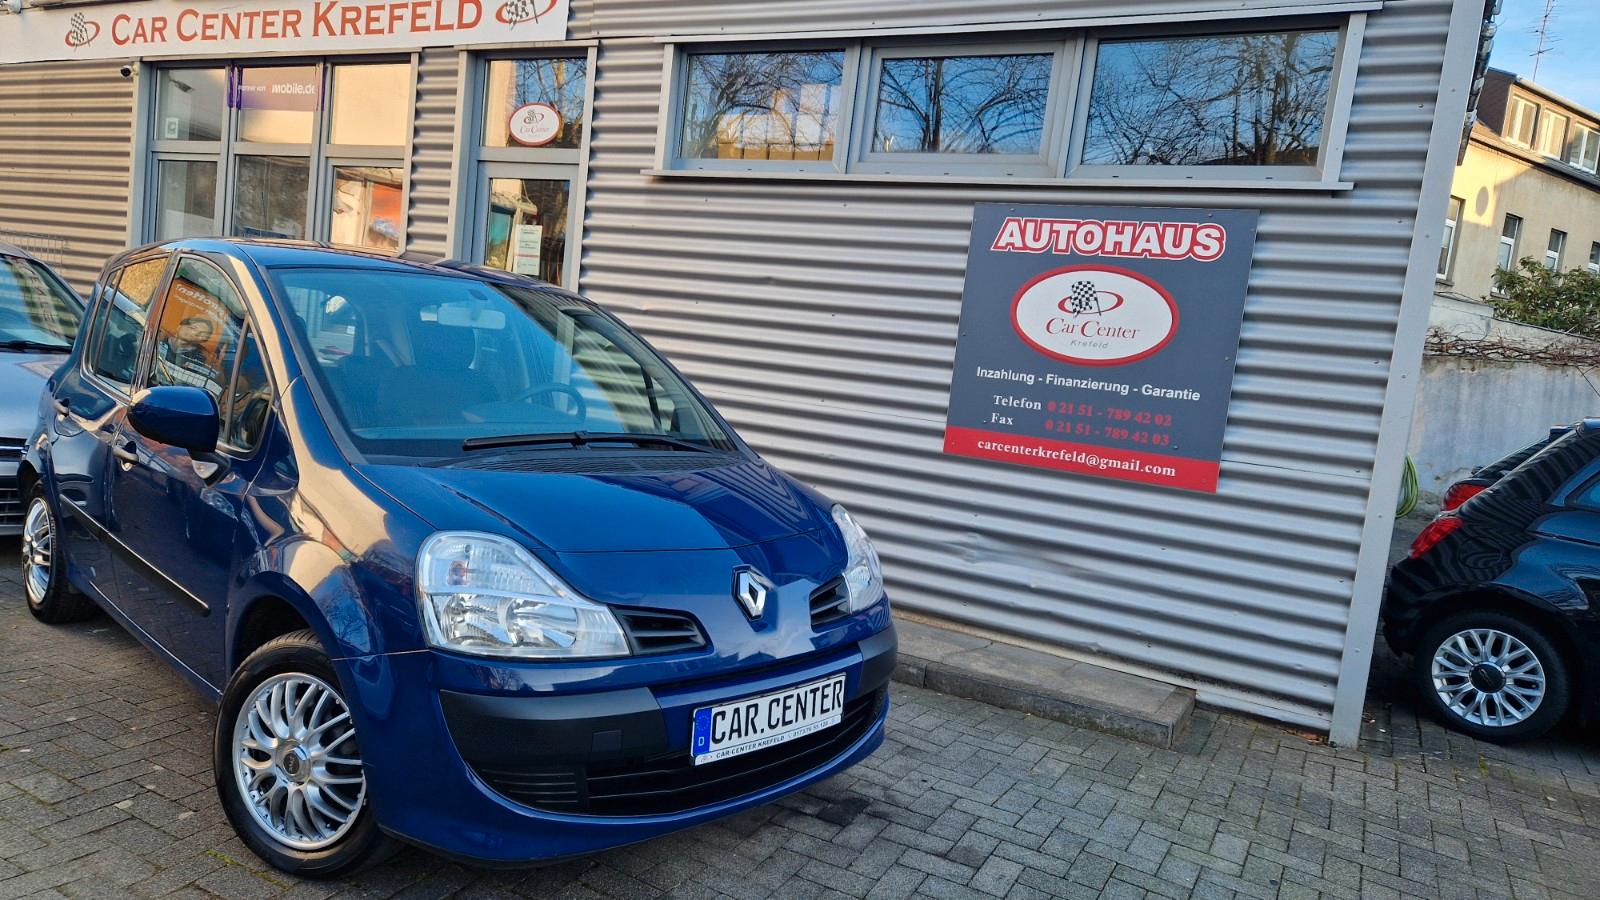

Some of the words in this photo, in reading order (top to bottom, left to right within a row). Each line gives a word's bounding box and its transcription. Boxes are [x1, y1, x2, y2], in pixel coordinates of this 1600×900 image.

[990, 216, 1227, 262] AUTOHAUS
[1046, 316, 1078, 335] Car
[1081, 319, 1141, 339] Center
[1070, 339, 1109, 349] Krefeld
[976, 366, 1035, 386] Inzahlung
[1046, 373, 1130, 396] Finanzierung
[1141, 384, 1201, 401] Garantie
[993, 395, 1042, 411] Telefon
[1059, 402, 1074, 415] 21
[1078, 404, 1093, 417] 51
[1106, 408, 1132, 421] 789
[1134, 411, 1151, 424] 42
[1154, 414, 1173, 427] 02
[991, 412, 1014, 426] Fax
[1056, 420, 1071, 433] 21
[1075, 423, 1090, 436] 51
[1104, 426, 1129, 440] 789
[1131, 430, 1148, 444] 42
[1151, 433, 1170, 446] 03
[977, 439, 1176, 477] carcenterkrefeld@gmail.com
[698, 736, 705, 747] D
[711, 679, 843, 744] CAR.CENTER
